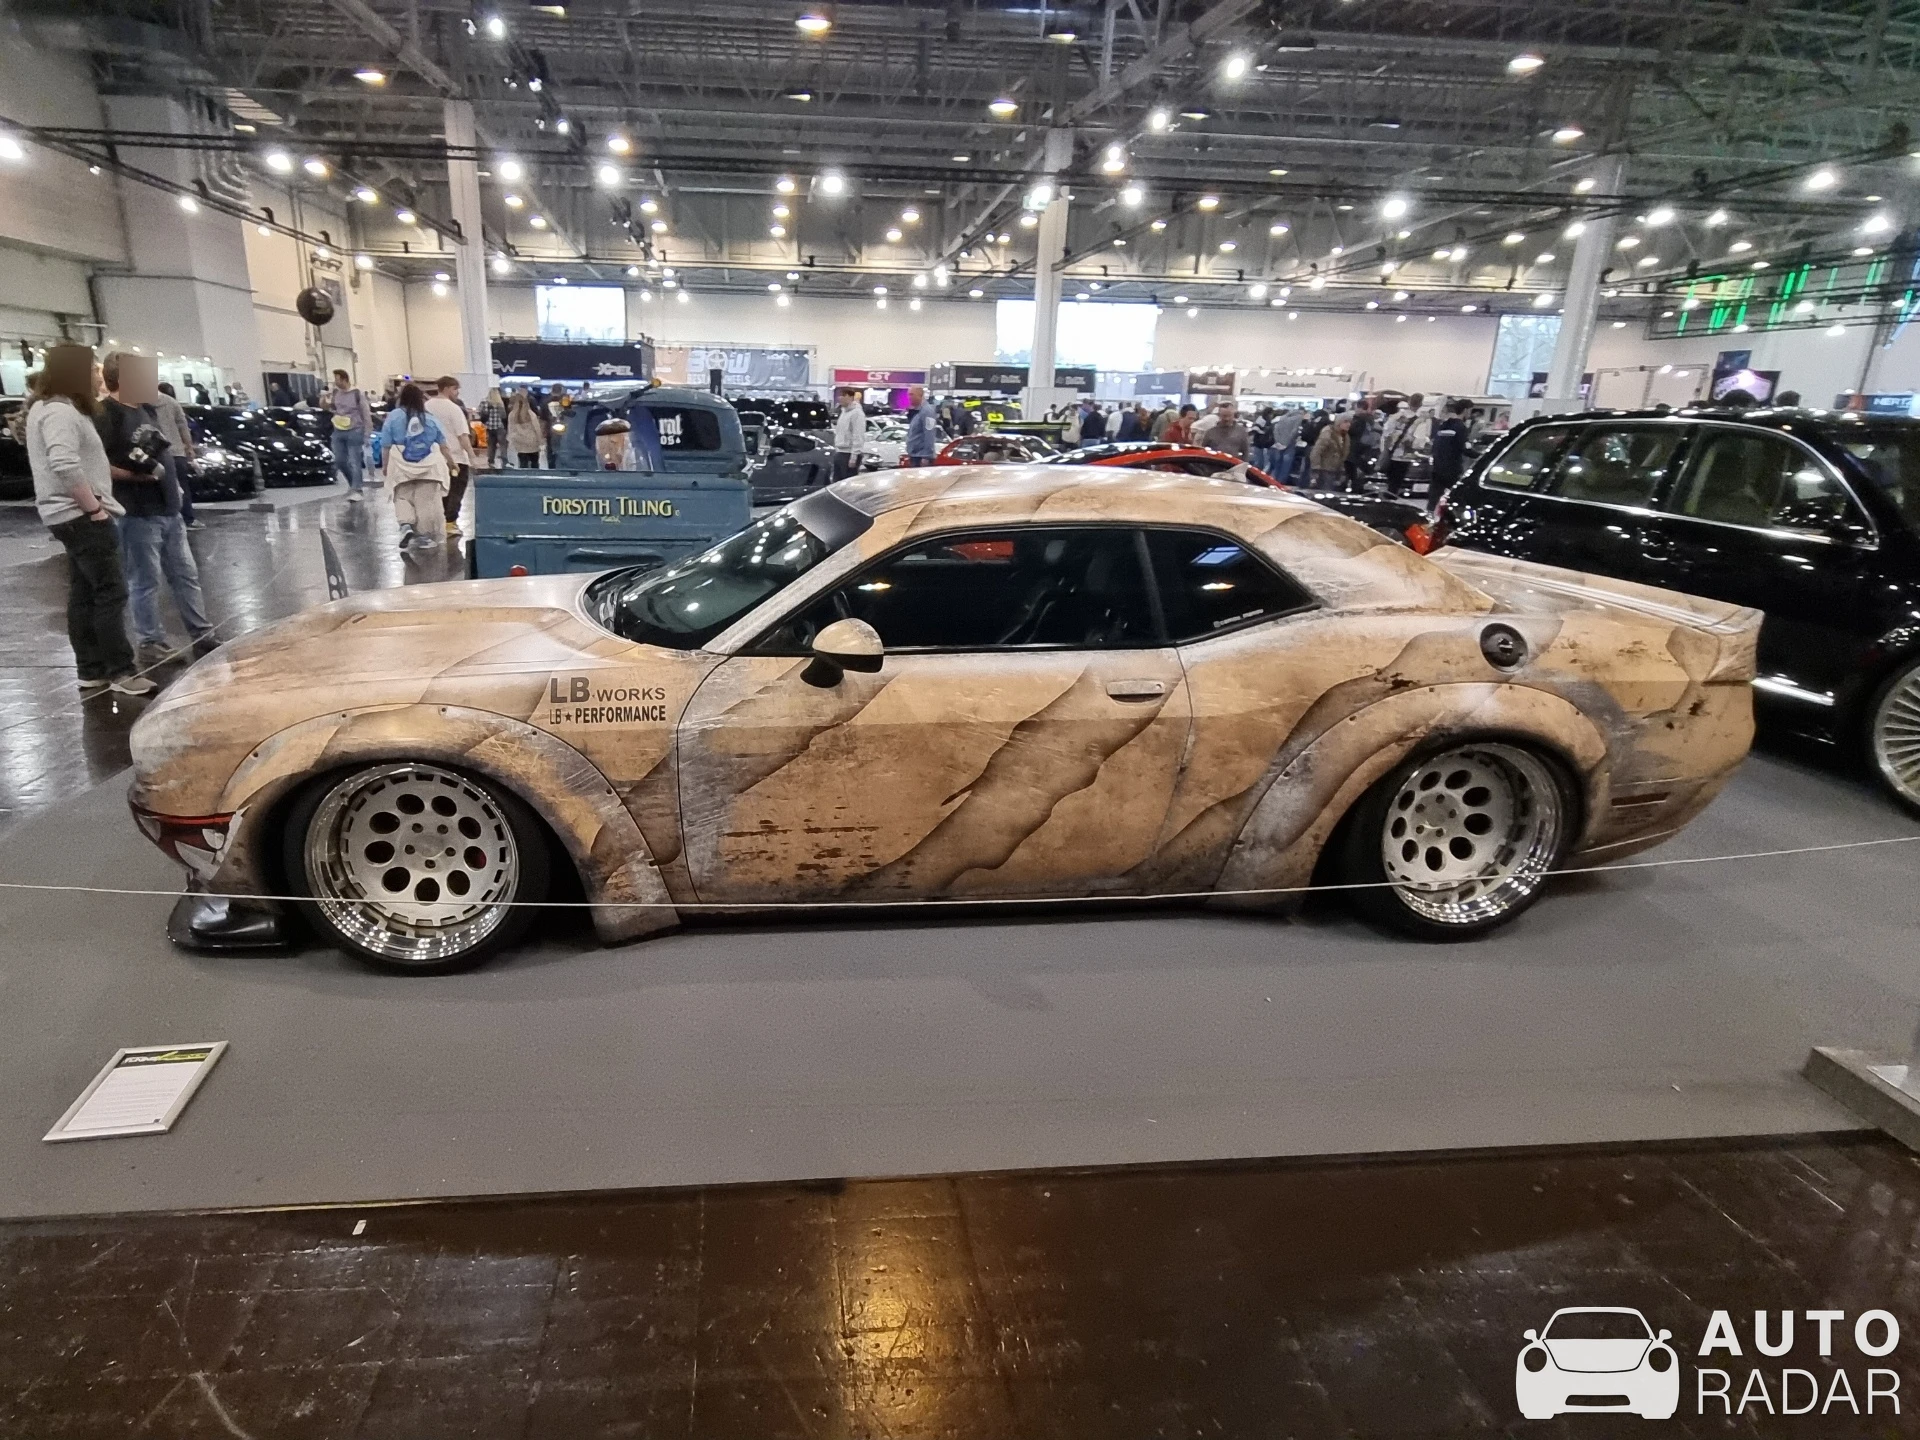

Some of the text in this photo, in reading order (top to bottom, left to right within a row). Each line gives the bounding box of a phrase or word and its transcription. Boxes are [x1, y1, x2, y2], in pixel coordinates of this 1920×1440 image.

[542, 495, 673, 517] FORSYTH TILING
[550, 677, 666, 704] LB WORKS
[549, 705, 666, 725] LB PERFORMANCE
